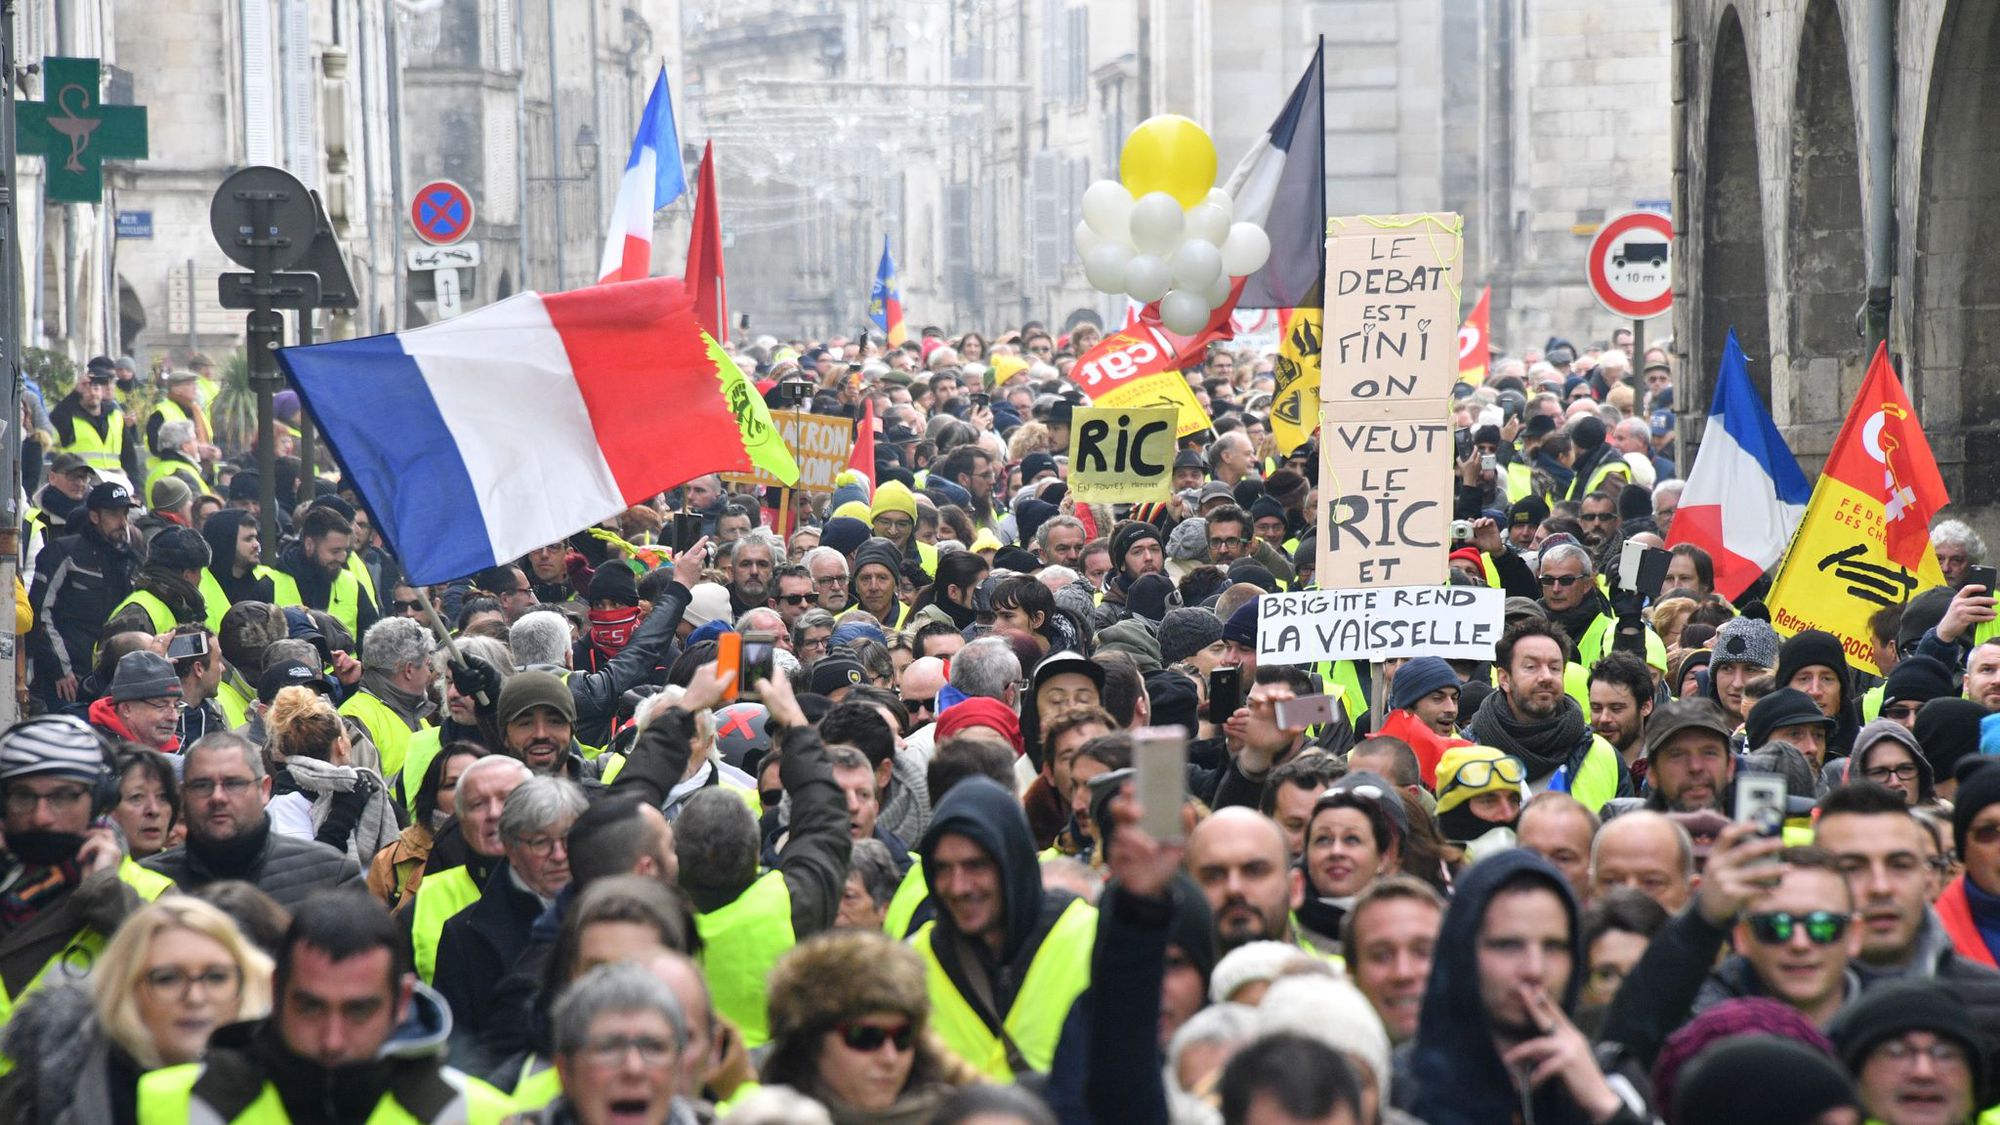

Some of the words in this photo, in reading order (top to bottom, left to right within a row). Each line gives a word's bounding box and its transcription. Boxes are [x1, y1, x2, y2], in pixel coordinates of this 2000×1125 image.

[1370, 237, 1416, 260] LE
[1338, 265, 1451, 296] DEBAT
[1626, 273, 1640, 283] 10
[1643, 275, 1655, 283] m
[1363, 305, 1416, 321] EST
[1350, 375, 1417, 398] ON
[1337, 425, 1448, 453] VEUT
[1077, 483, 1090, 493] EN
[1361, 468, 1409, 491] LE
[1834, 510, 1862, 529] DES
[1359, 558, 1401, 583] ET
[1394, 589, 1476, 607] REND
[1261, 624, 1300, 654] LA
[1843, 636, 1879, 668] ROCH
